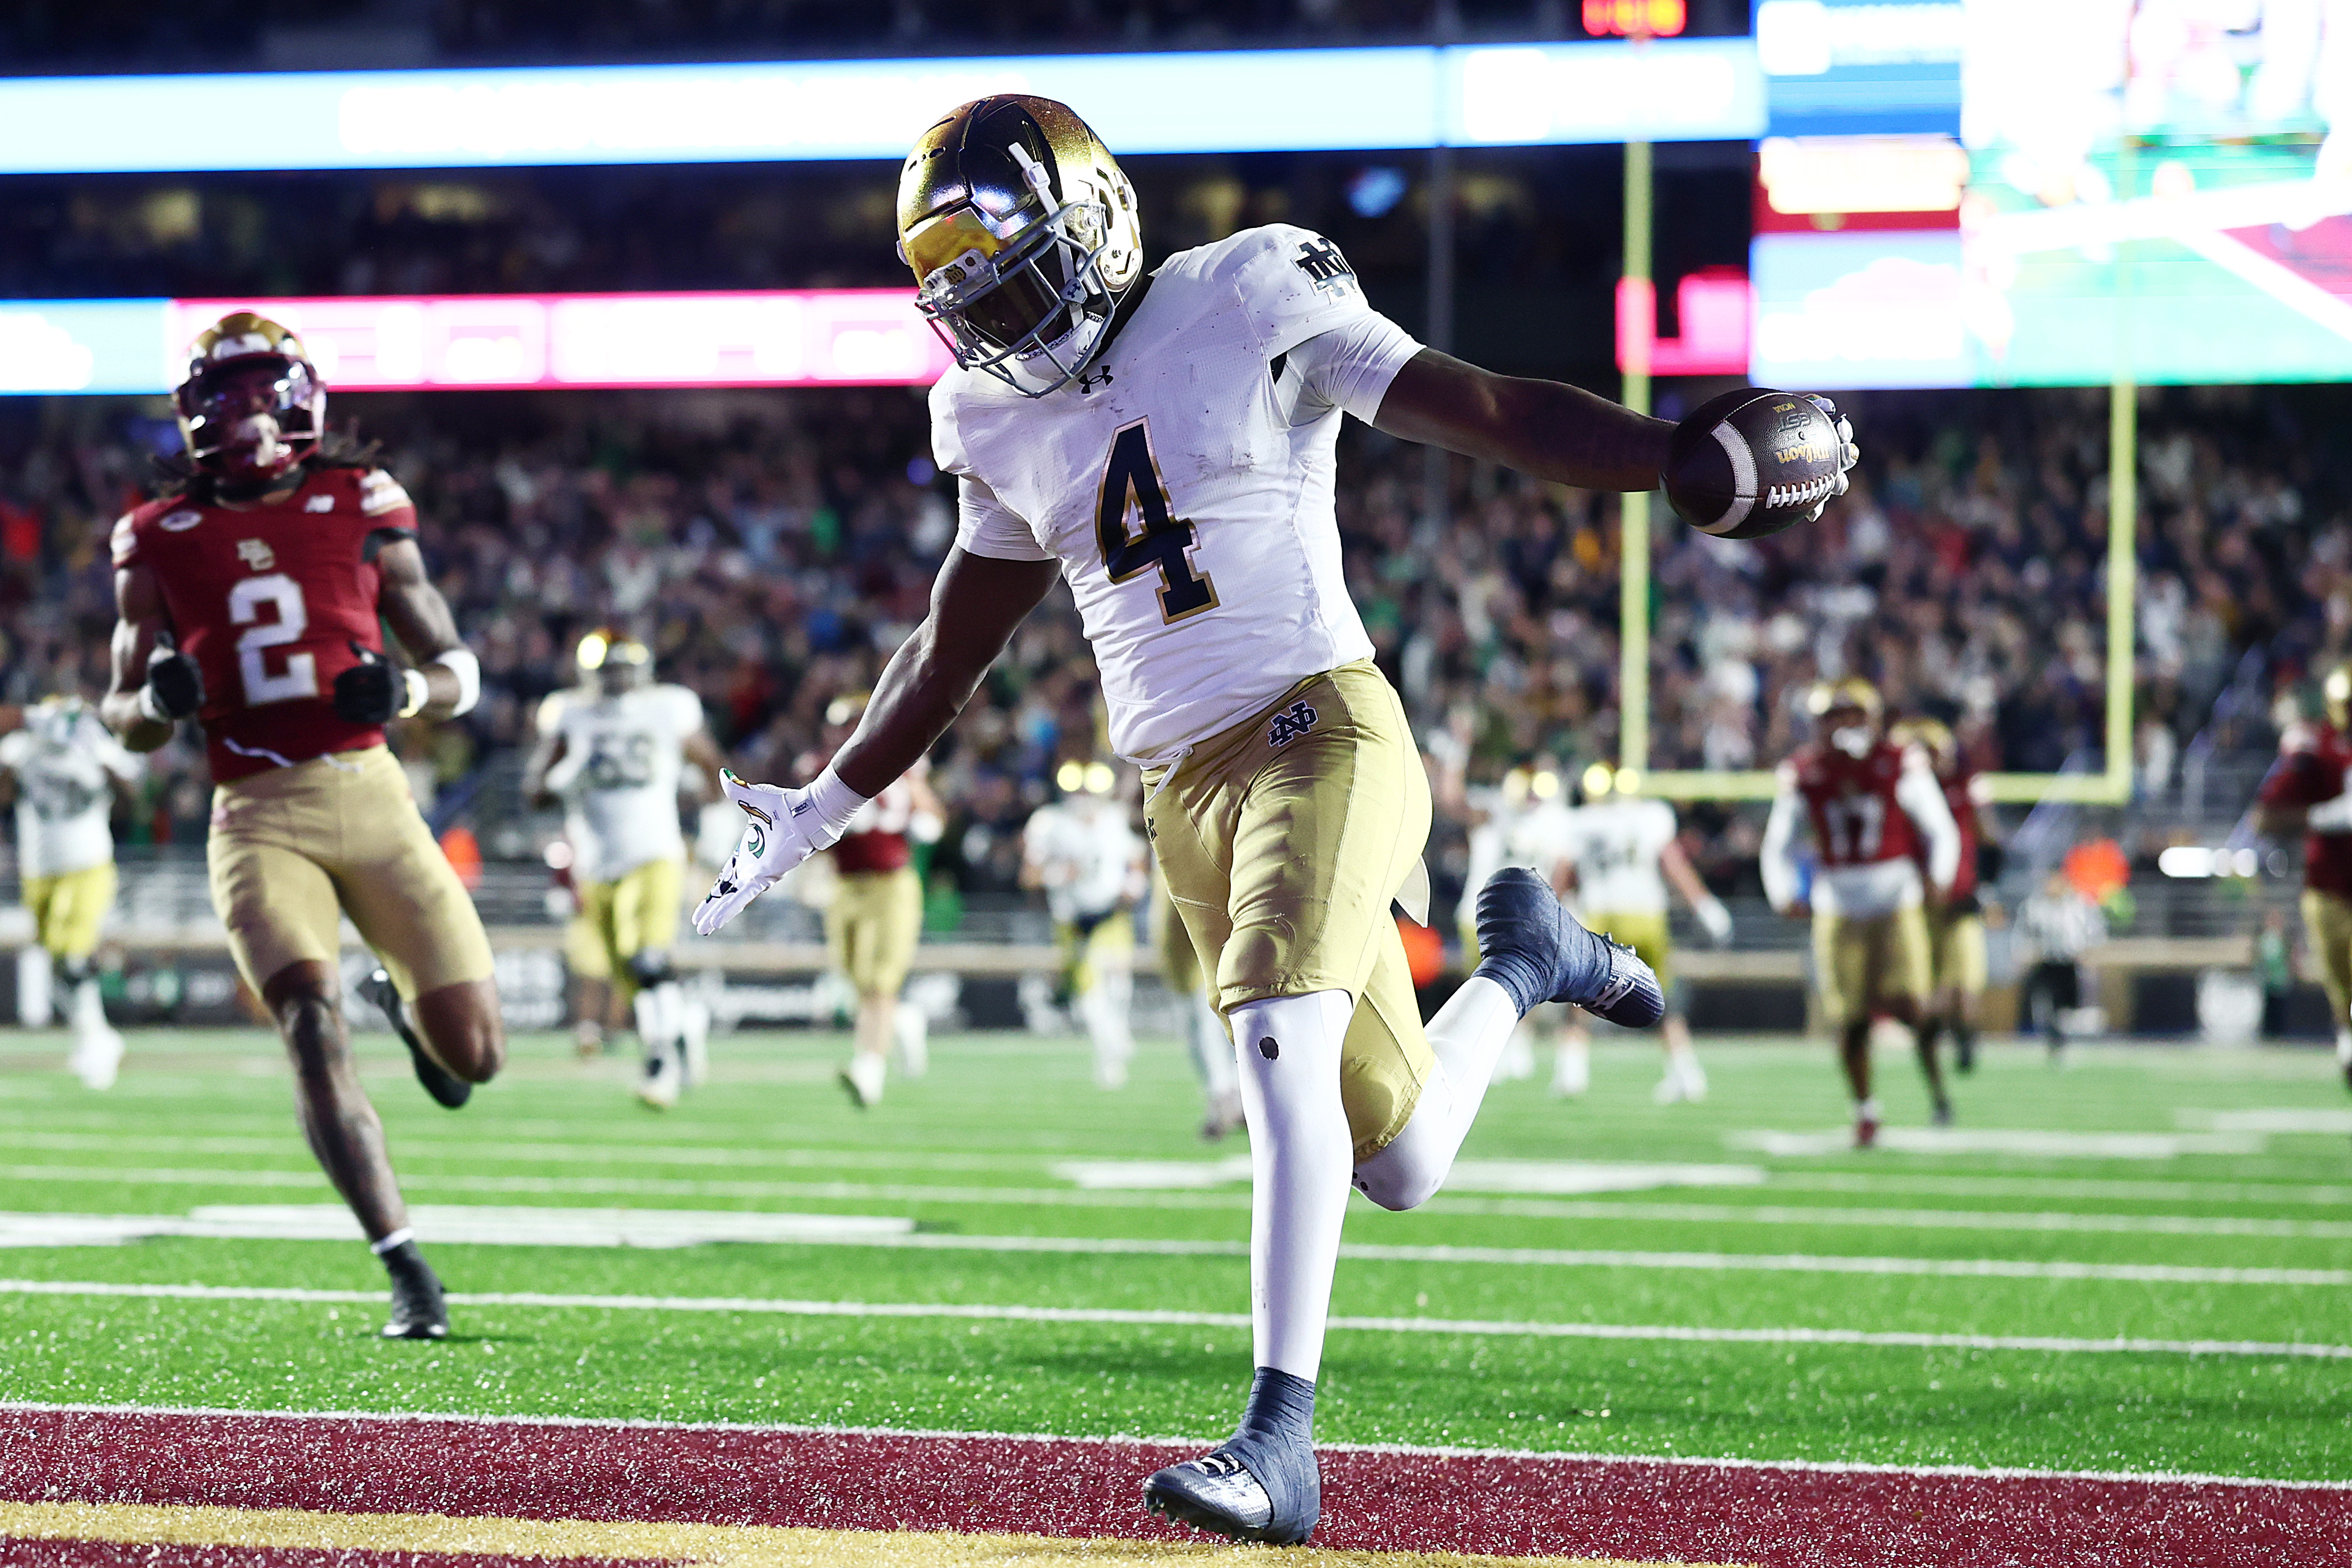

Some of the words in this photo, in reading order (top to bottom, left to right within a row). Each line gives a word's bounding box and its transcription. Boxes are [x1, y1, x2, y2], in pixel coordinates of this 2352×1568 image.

[1772, 402, 1796, 413] NCAA
[1775, 442, 1831, 464] Wilson
[1095, 415, 1220, 625] 4
[228, 572, 319, 706] 2
[1267, 700, 1319, 748] ND
